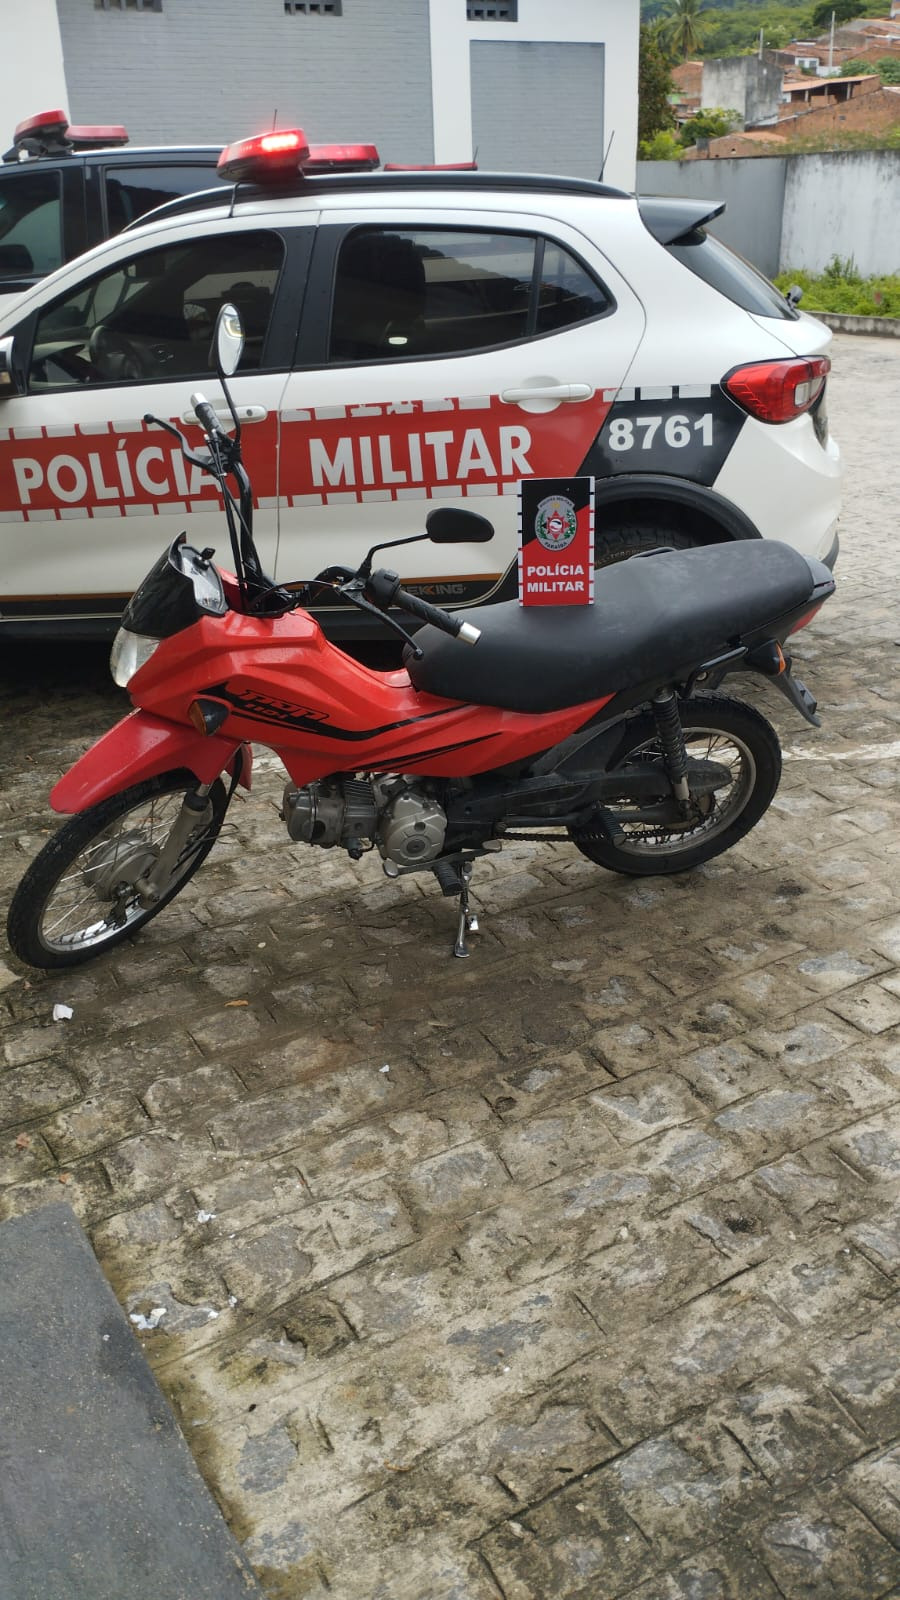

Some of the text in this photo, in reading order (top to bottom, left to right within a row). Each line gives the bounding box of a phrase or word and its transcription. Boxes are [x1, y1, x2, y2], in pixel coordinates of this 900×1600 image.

[608, 413, 714, 451] 8761
[309, 425, 534, 487] MILITAR
[527, 563, 584, 577] POLÍCIA
[527, 581, 584, 592] MILITAR
